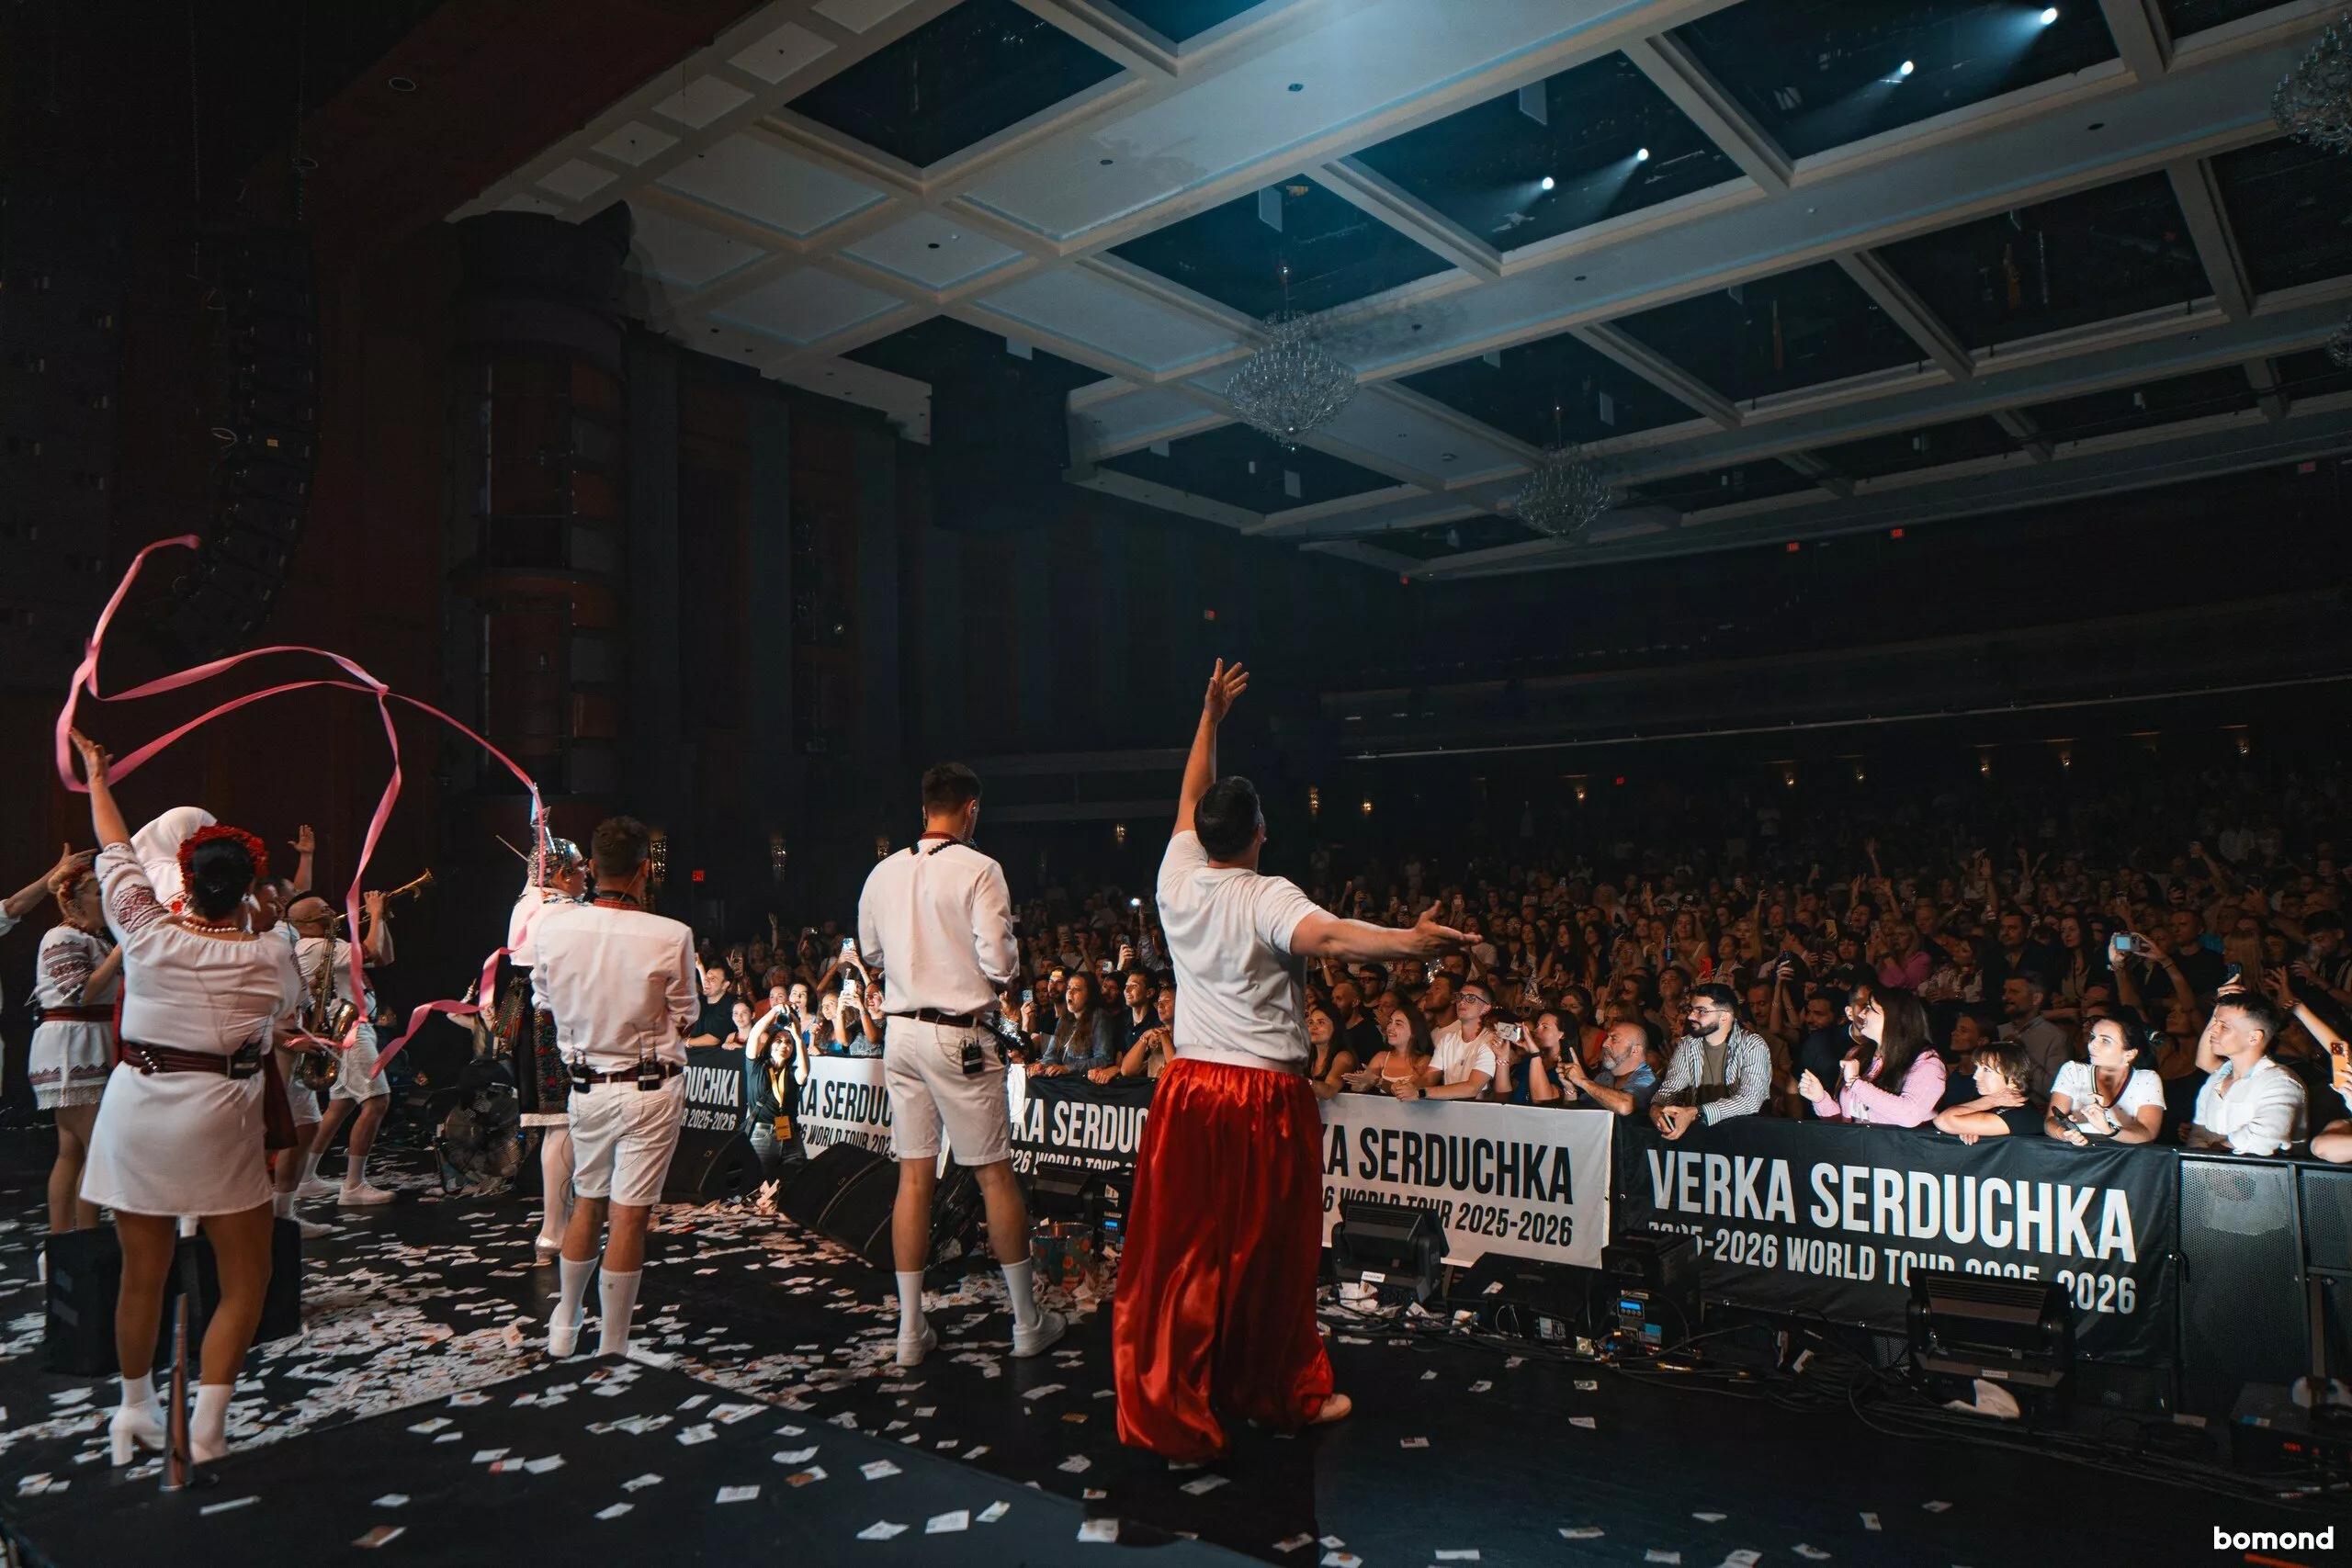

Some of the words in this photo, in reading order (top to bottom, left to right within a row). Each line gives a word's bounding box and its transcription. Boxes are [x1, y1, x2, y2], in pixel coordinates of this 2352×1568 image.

[687, 1109, 737, 1131] 2025-2026
[871, 1134, 897, 1157] 202
[1323, 1123, 1349, 1177] A
[1359, 1126, 1574, 1205] SERDUCHKA
[1454, 1201, 1574, 1247] 2025-2026
[1646, 1149, 1797, 1224] VERKA
[1810, 1162, 2137, 1263] SERDUCHKA
[1648, 1222, 1779, 1269] -2026
[1787, 1236, 1876, 1281] WORLD
